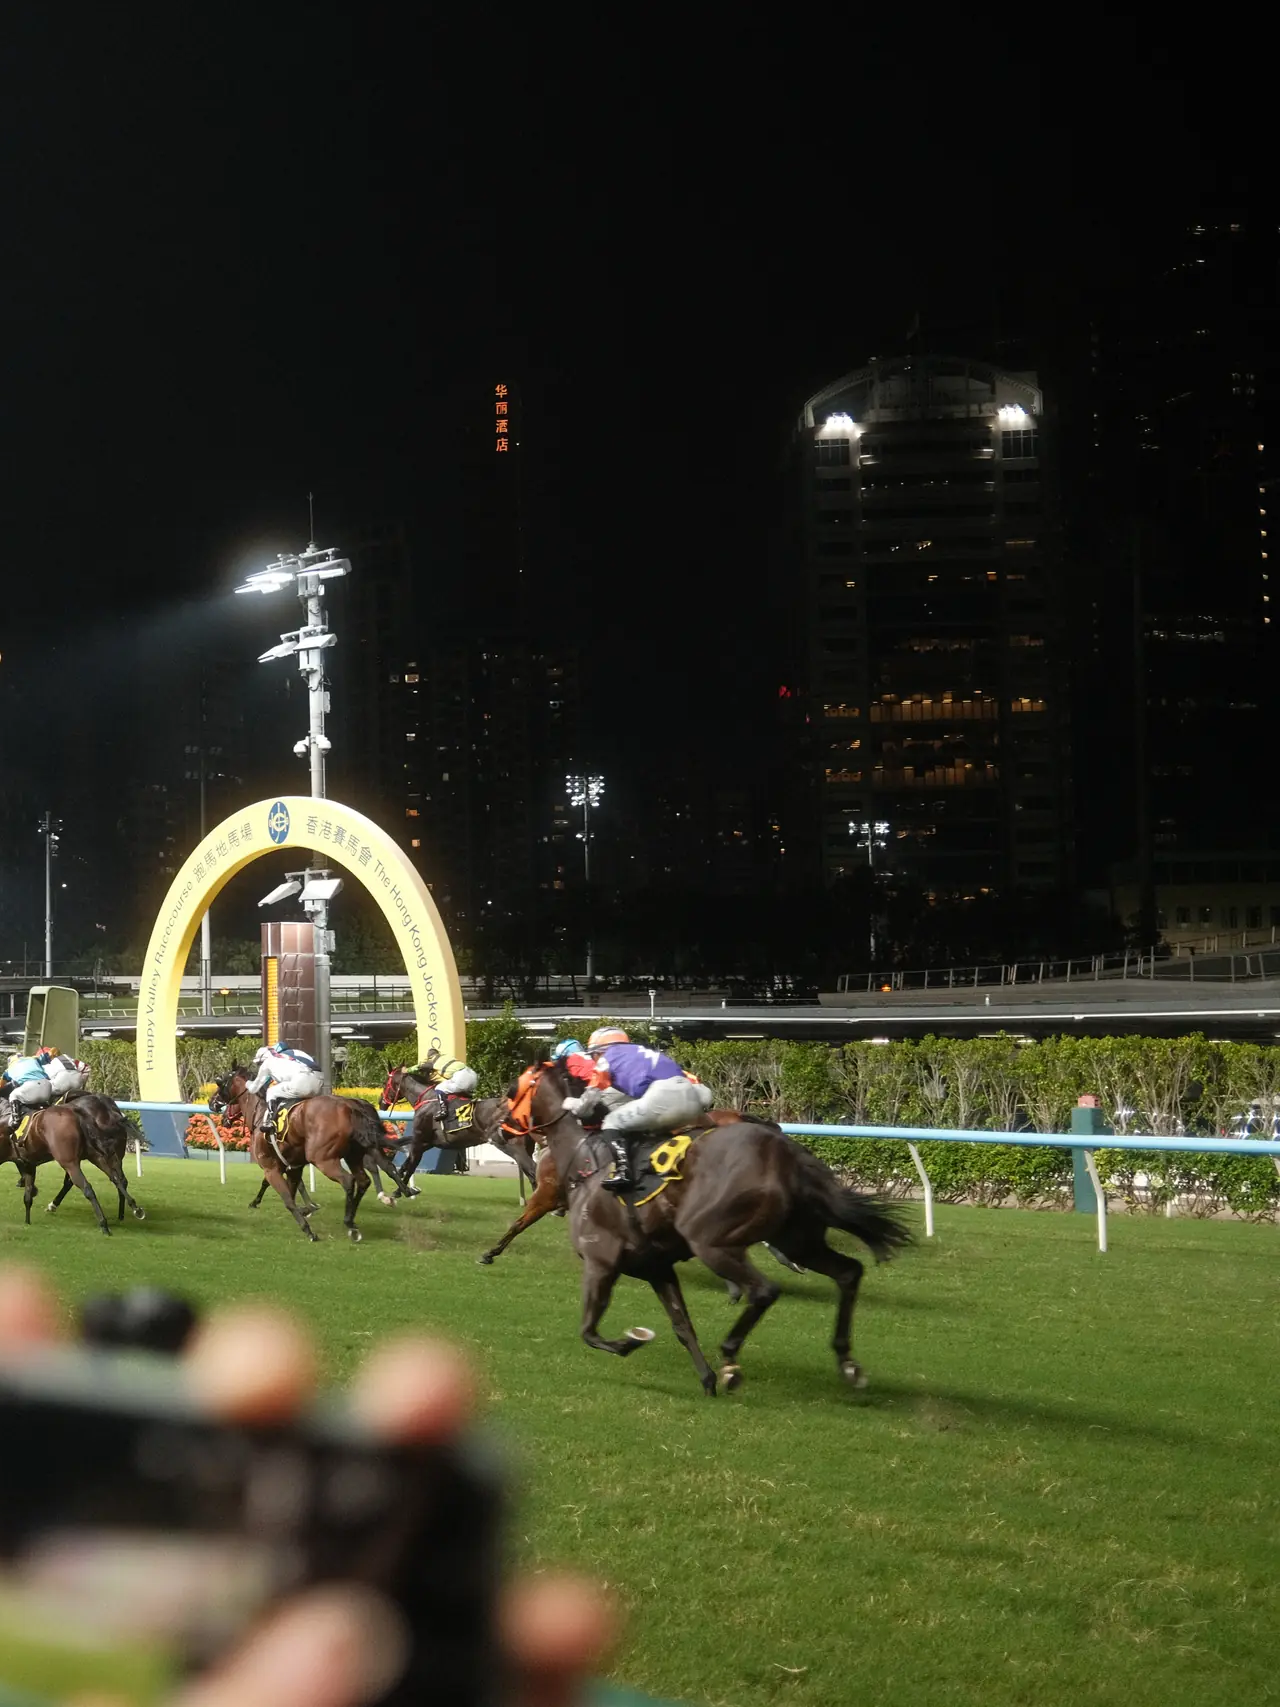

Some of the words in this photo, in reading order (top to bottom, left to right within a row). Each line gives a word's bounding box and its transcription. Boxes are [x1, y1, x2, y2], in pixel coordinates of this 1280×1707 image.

[192, 822, 253, 884] 跑馬地馬場
[154, 881, 193, 965] Racecourse
[305, 815, 373, 868] 香港賽馬會
[374, 859, 391, 888] The
[389, 884, 413, 927] Hong
[408, 924, 428, 969] Kong
[422, 972, 438, 1032] Jockey
[146, 969, 161, 1014] Valley
[146, 1019, 156, 1071] Happy
